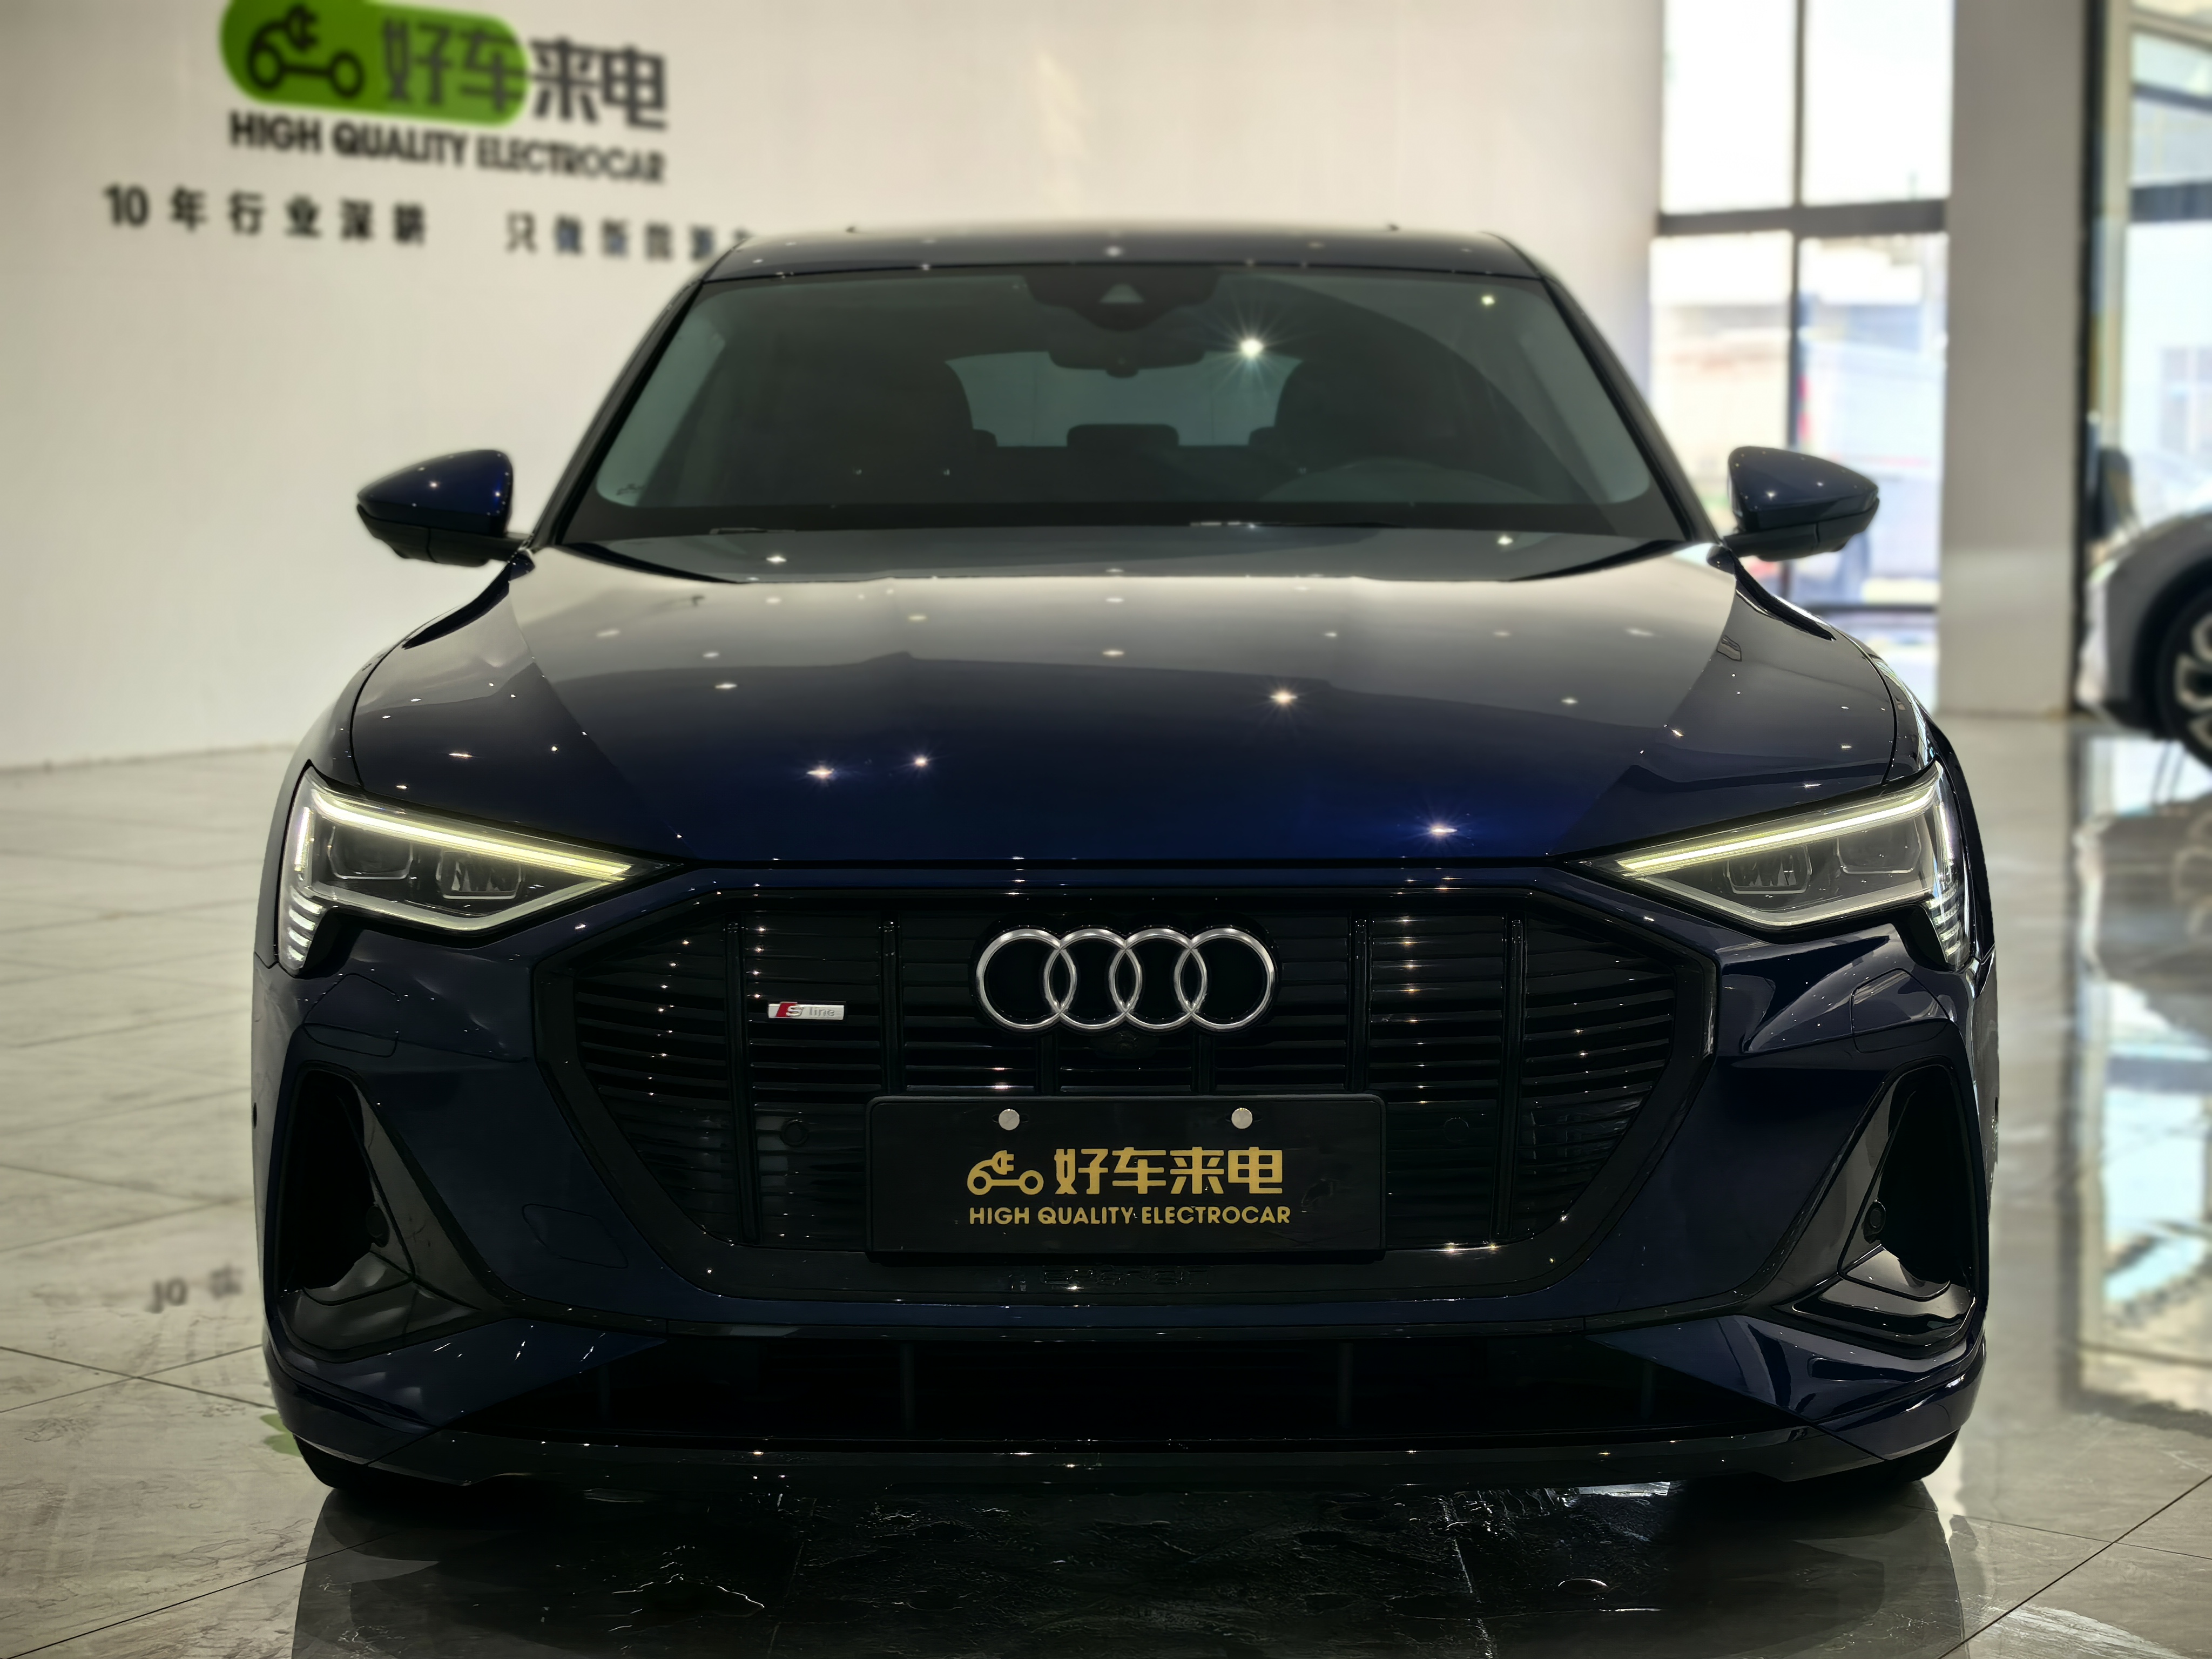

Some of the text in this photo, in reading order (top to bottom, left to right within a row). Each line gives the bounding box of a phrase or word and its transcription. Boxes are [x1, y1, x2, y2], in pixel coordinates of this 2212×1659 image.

[382, 18, 667, 131] 好车来电
[229, 110, 666, 184] HIGH QUALITY ELECTROCAR
[809, 1007, 835, 1017] line
[1054, 1147, 1283, 1195] 好车来电
[970, 1206, 1291, 1225] HIGH QUALITY ELECTROCAR
